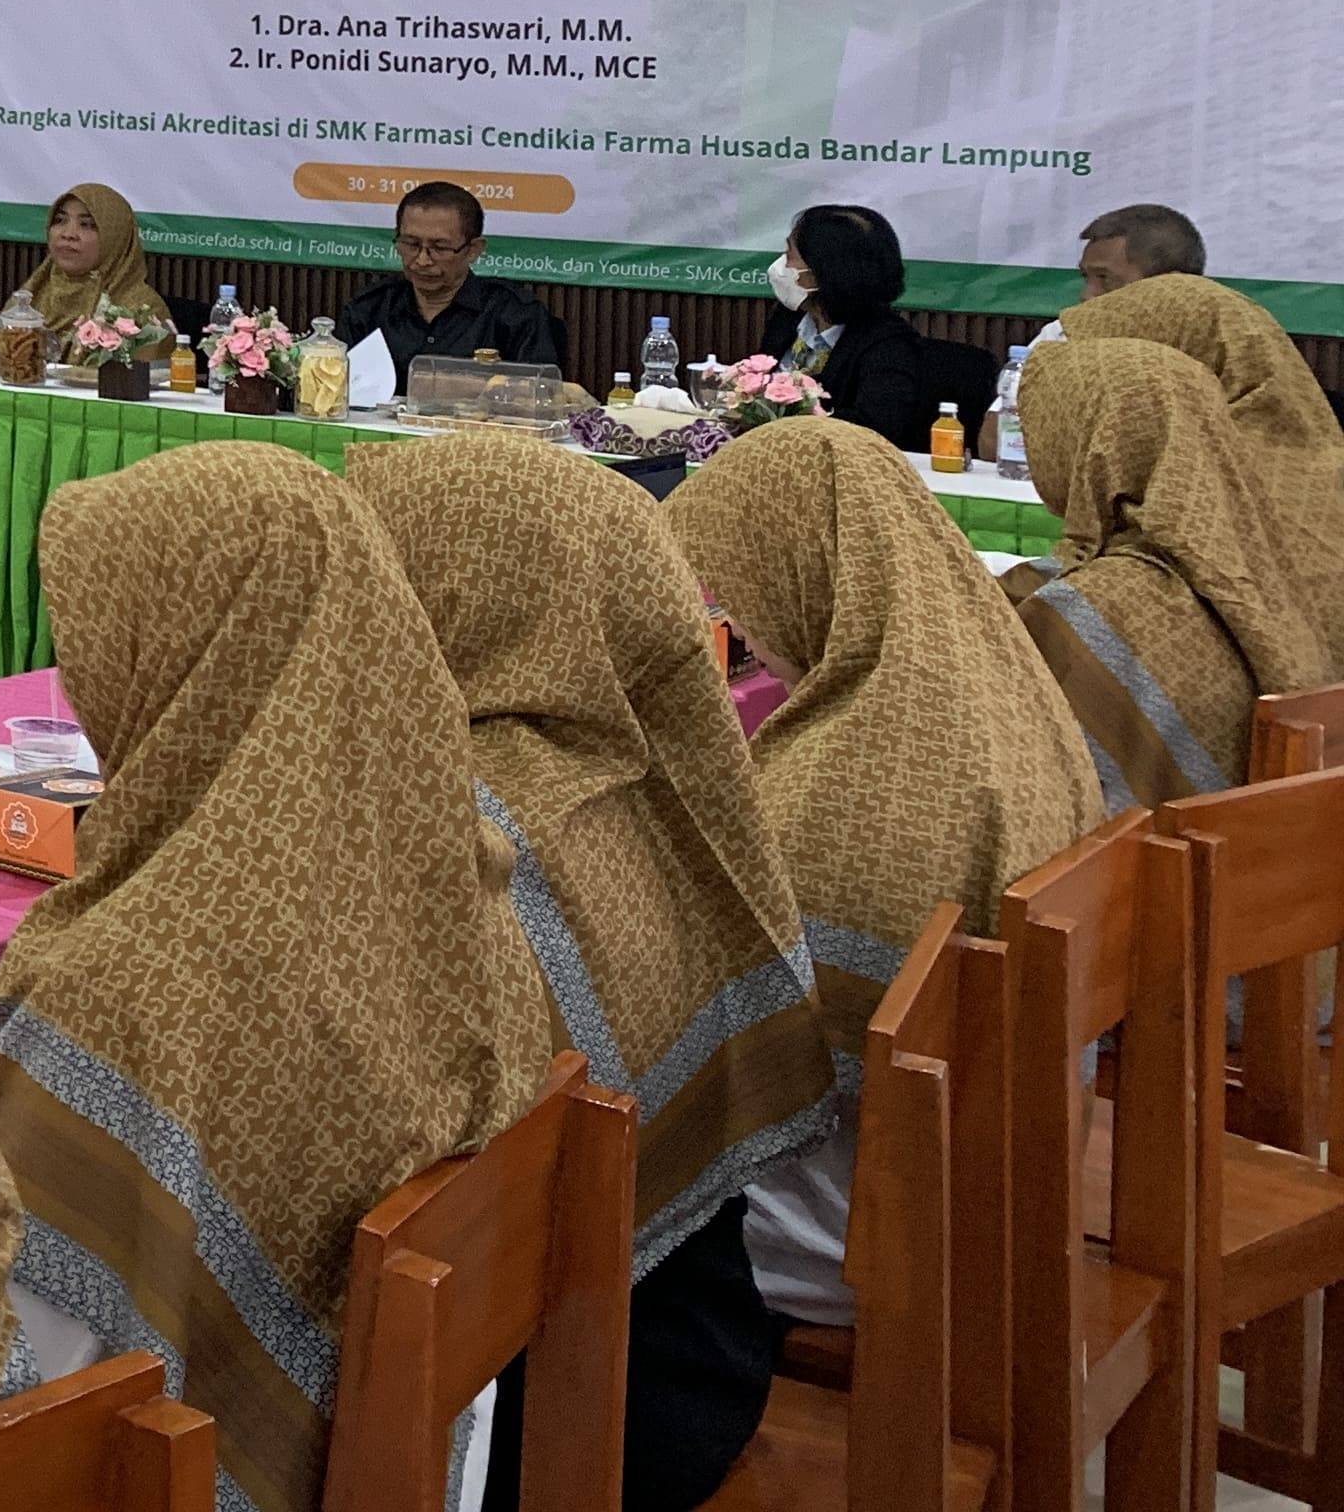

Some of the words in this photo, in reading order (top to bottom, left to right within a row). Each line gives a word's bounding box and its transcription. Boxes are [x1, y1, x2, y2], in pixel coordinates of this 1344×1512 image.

[251, 14, 270, 36] 1.
[278, 15, 330, 37] Dra.
[337, 16, 388, 38] Ana
[395, 16, 552, 45] Trihaswari,
[561, 18, 632, 43] M.M.
[229, 48, 250, 69] 2.
[257, 49, 283, 70] Ir.
[290, 49, 370, 73] Ponidi
[378, 51, 497, 81] Sunaryo,
[507, 53, 585, 81] M.M.,
[594, 55, 657, 79] MCE
[77, 109, 156, 132] Visitasi
[162, 112, 280, 138] Akreditasi
[287, 117, 308, 139] di
[316, 120, 365, 142] SMK
[374, 122, 473, 147] Farmasi
[481, 126, 595, 151] Cendikia
[604, 131, 691, 156] Farma
[701, 134, 811, 161] Husada
[820, 138, 933, 164] Bandar
[942, 141, 1092, 176] Lampung
[348, 177, 366, 192] 30
[379, 178, 396, 193] 31
[476, 183, 515, 199] 2024
[138, 227, 292, 253] kfarmasicefada.sch.id
[309, 240, 357, 258] Follow
[361, 243, 385, 259] Us:
[562, 257, 594, 273] dan
[599, 259, 670, 279] Youtube
[685, 265, 724, 281] SMK
[728, 268, 768, 285] Cefa
